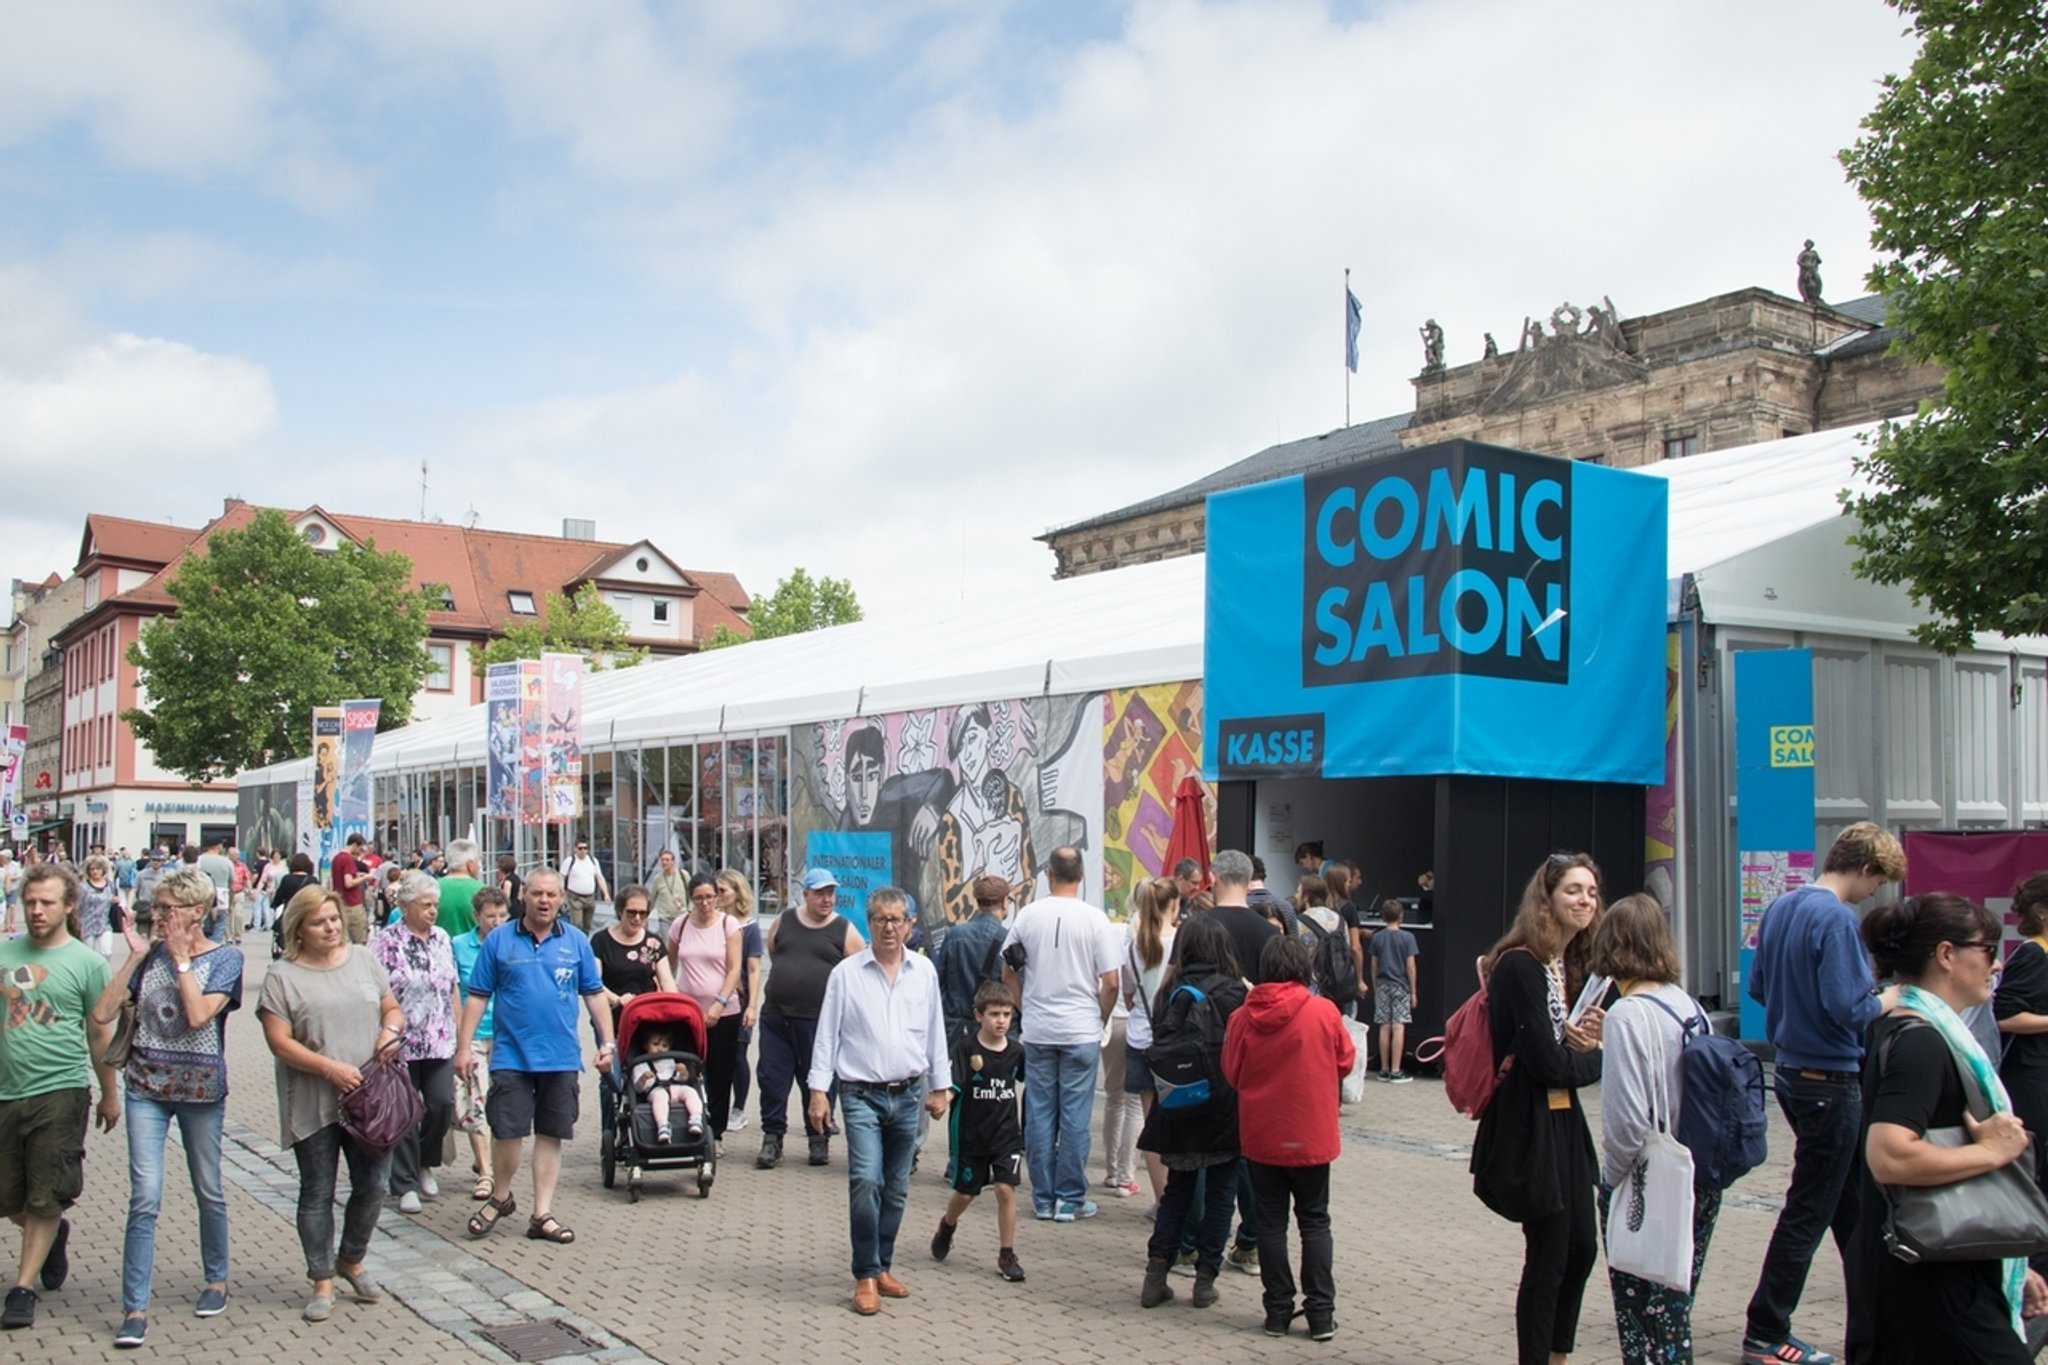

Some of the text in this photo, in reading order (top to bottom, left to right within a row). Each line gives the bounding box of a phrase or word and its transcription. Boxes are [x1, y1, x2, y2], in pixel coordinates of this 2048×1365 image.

[1315, 467, 1563, 567] COMIC
[1313, 569, 1563, 667] SALON
[1227, 729, 1314, 766] KASSE
[1775, 748, 1815, 764] SAL
[145, 803, 216, 814] MAXIMILIAN
[812, 854, 886, 870] INTERNATIONALER
[835, 876, 869, 890] -SALON
[990, 1078, 1006, 1088] Fly
[1010, 1154, 1021, 1174] 7
